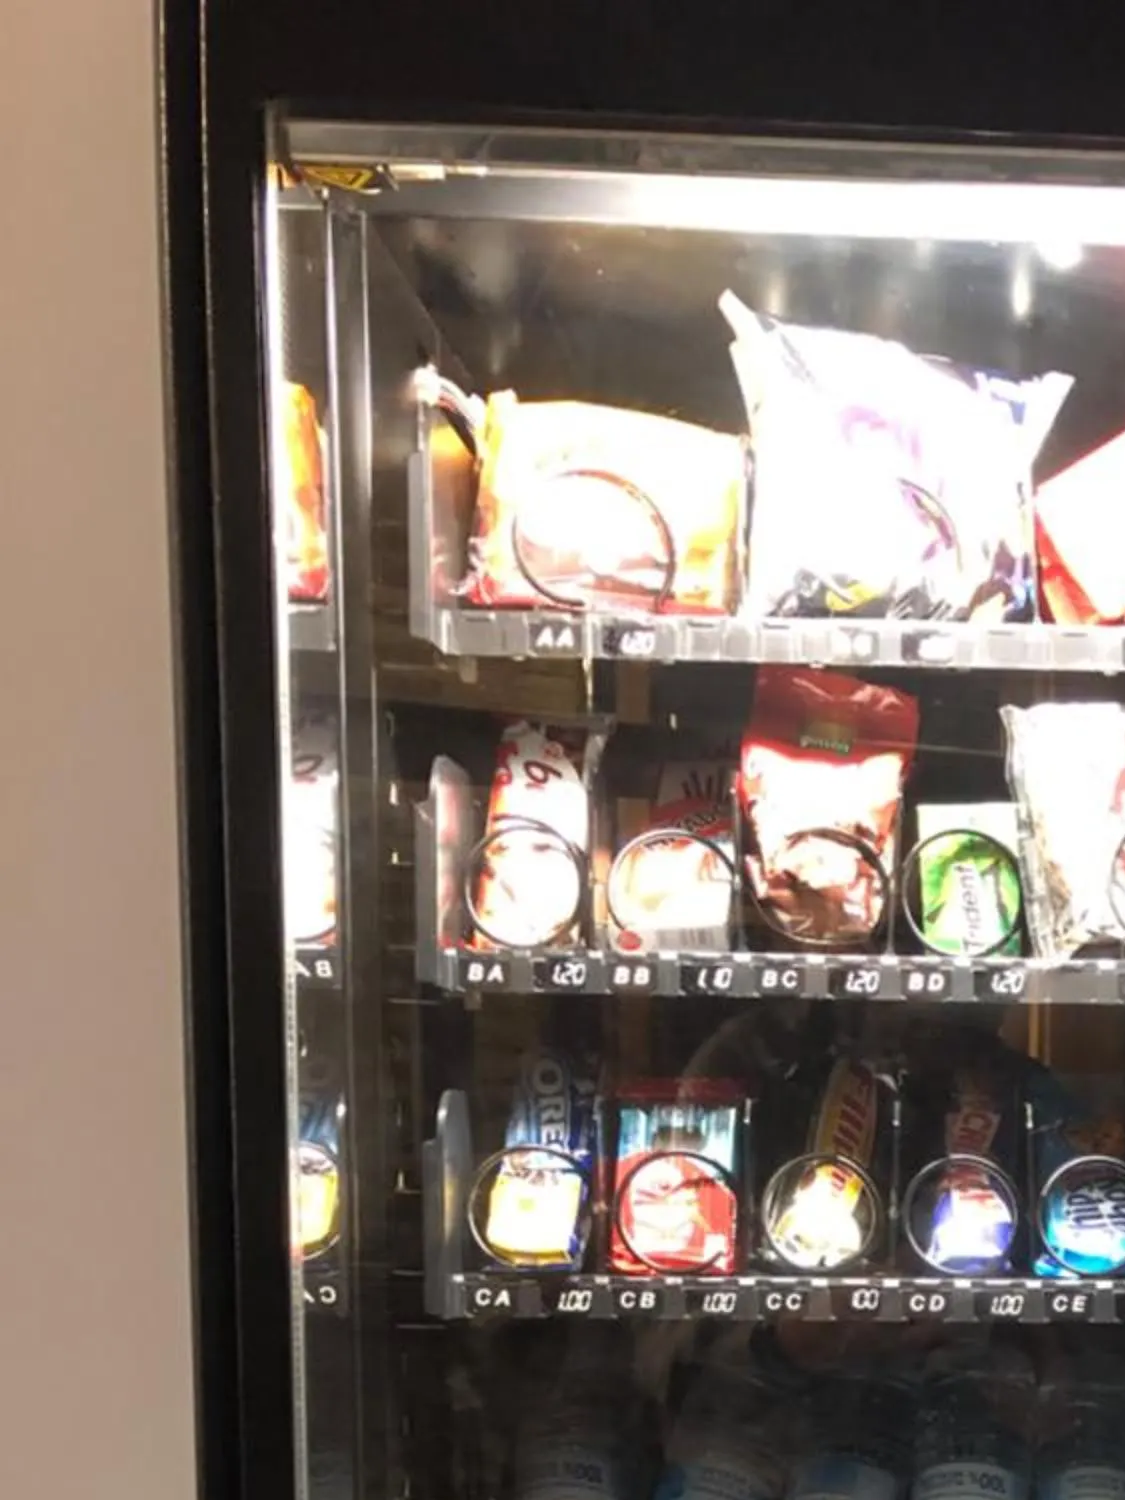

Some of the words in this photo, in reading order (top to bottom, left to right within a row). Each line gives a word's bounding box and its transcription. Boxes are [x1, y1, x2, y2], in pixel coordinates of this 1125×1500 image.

[537, 628, 574, 649] AA
[467, 962, 504, 982] BA
[613, 965, 650, 985] BB
[761, 969, 798, 989] BC
[908, 972, 945, 992] BD
[475, 1288, 510, 1306] CA
[620, 1290, 656, 1309] CB
[766, 1292, 802, 1311] CC
[909, 1294, 945, 1312] CD
[1052, 1294, 1087, 1313] CE
